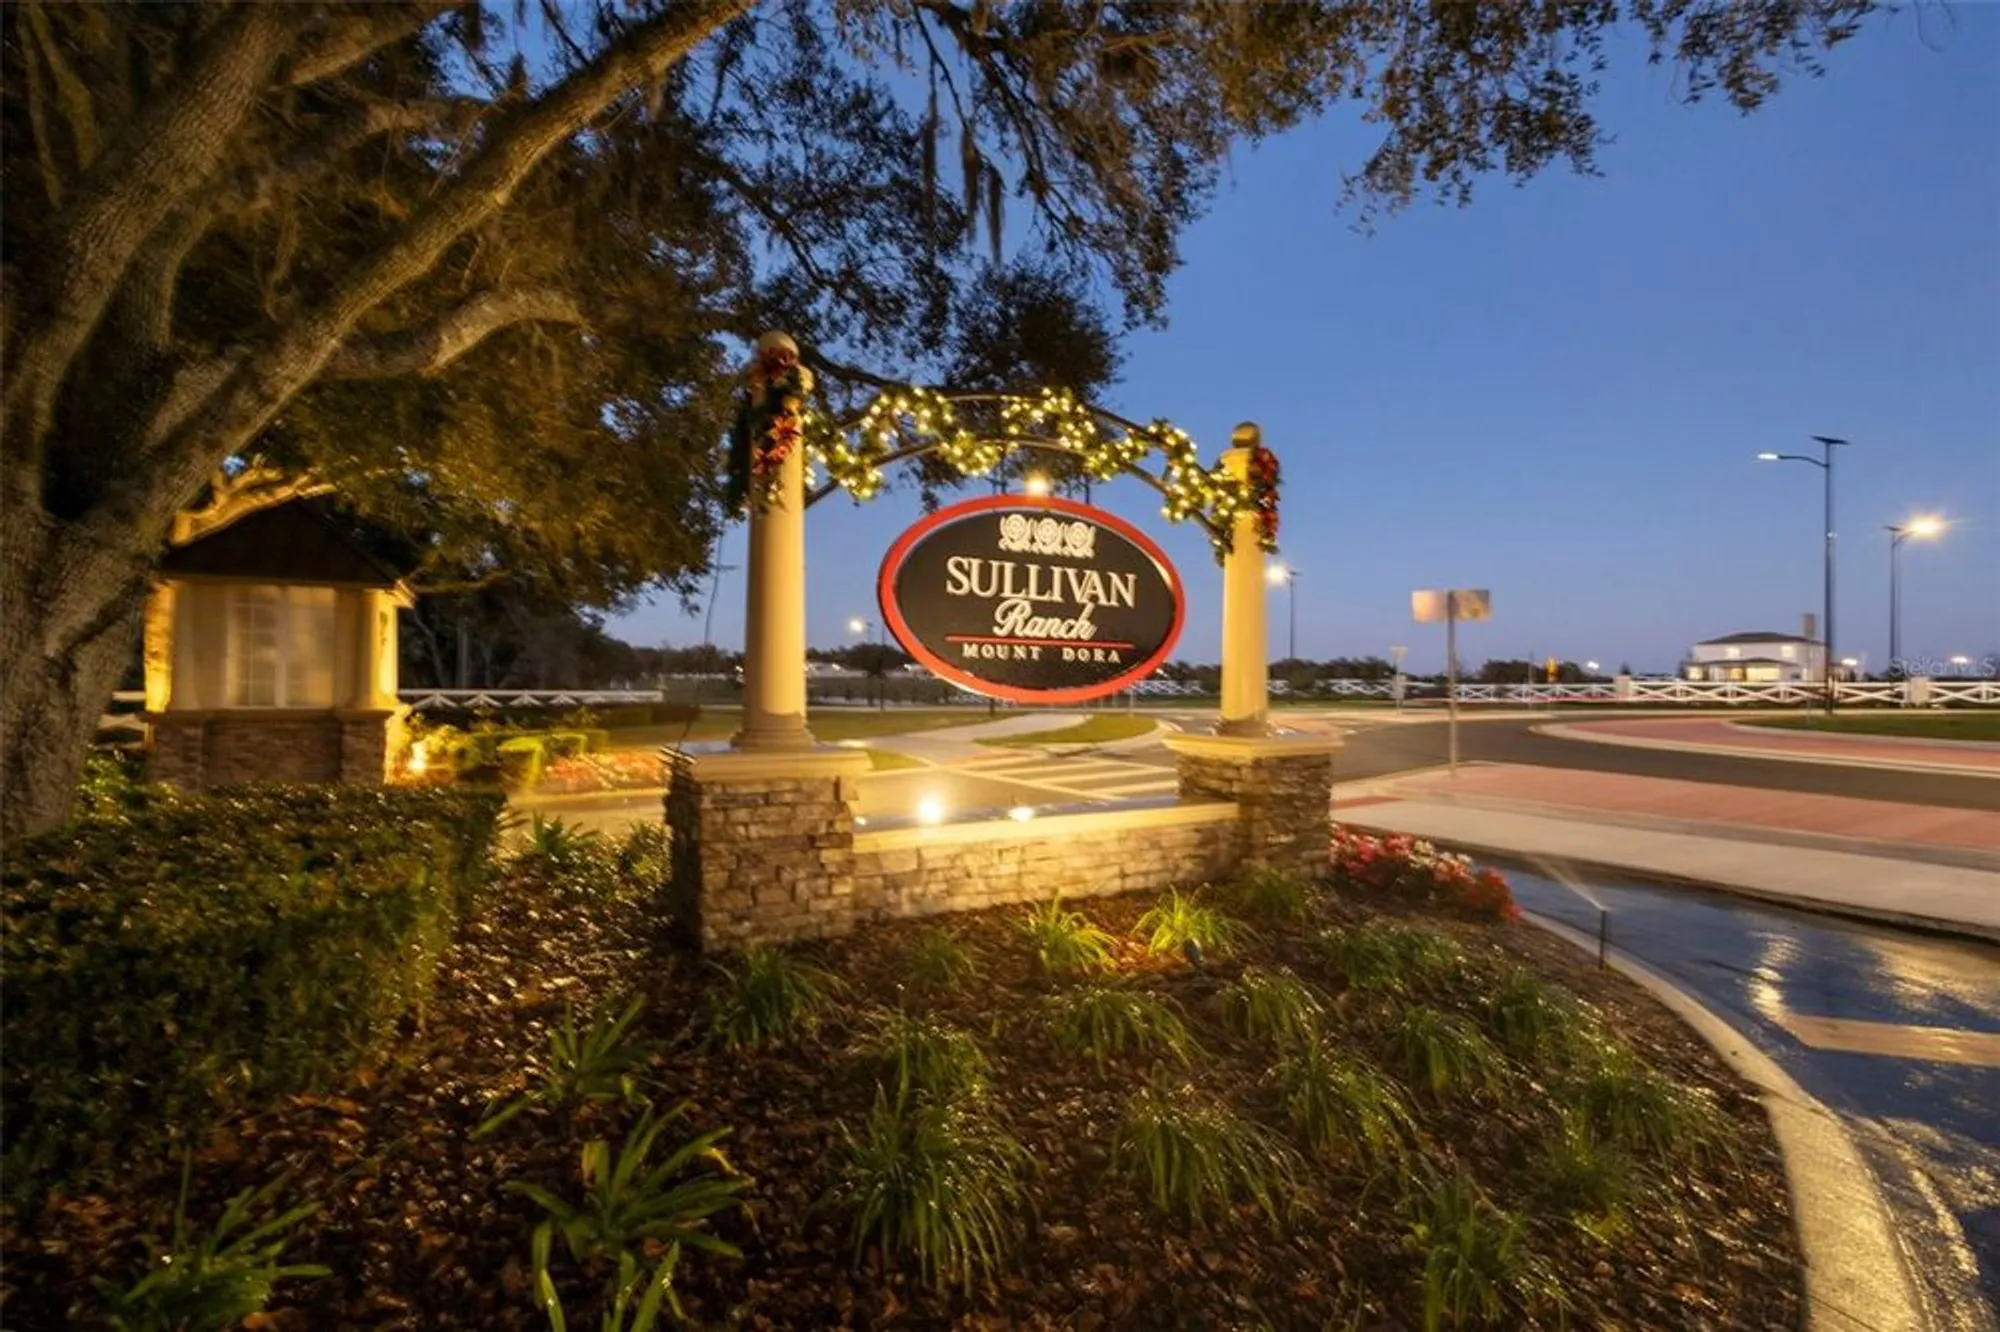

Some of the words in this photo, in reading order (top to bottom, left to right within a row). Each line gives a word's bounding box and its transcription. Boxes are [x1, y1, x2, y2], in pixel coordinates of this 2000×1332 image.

[946, 556, 1136, 607] SULLIVAN
[992, 598, 1096, 639] Ranch
[962, 643, 1041, 660] MOUNT
[1062, 647, 1120, 663] DORA
